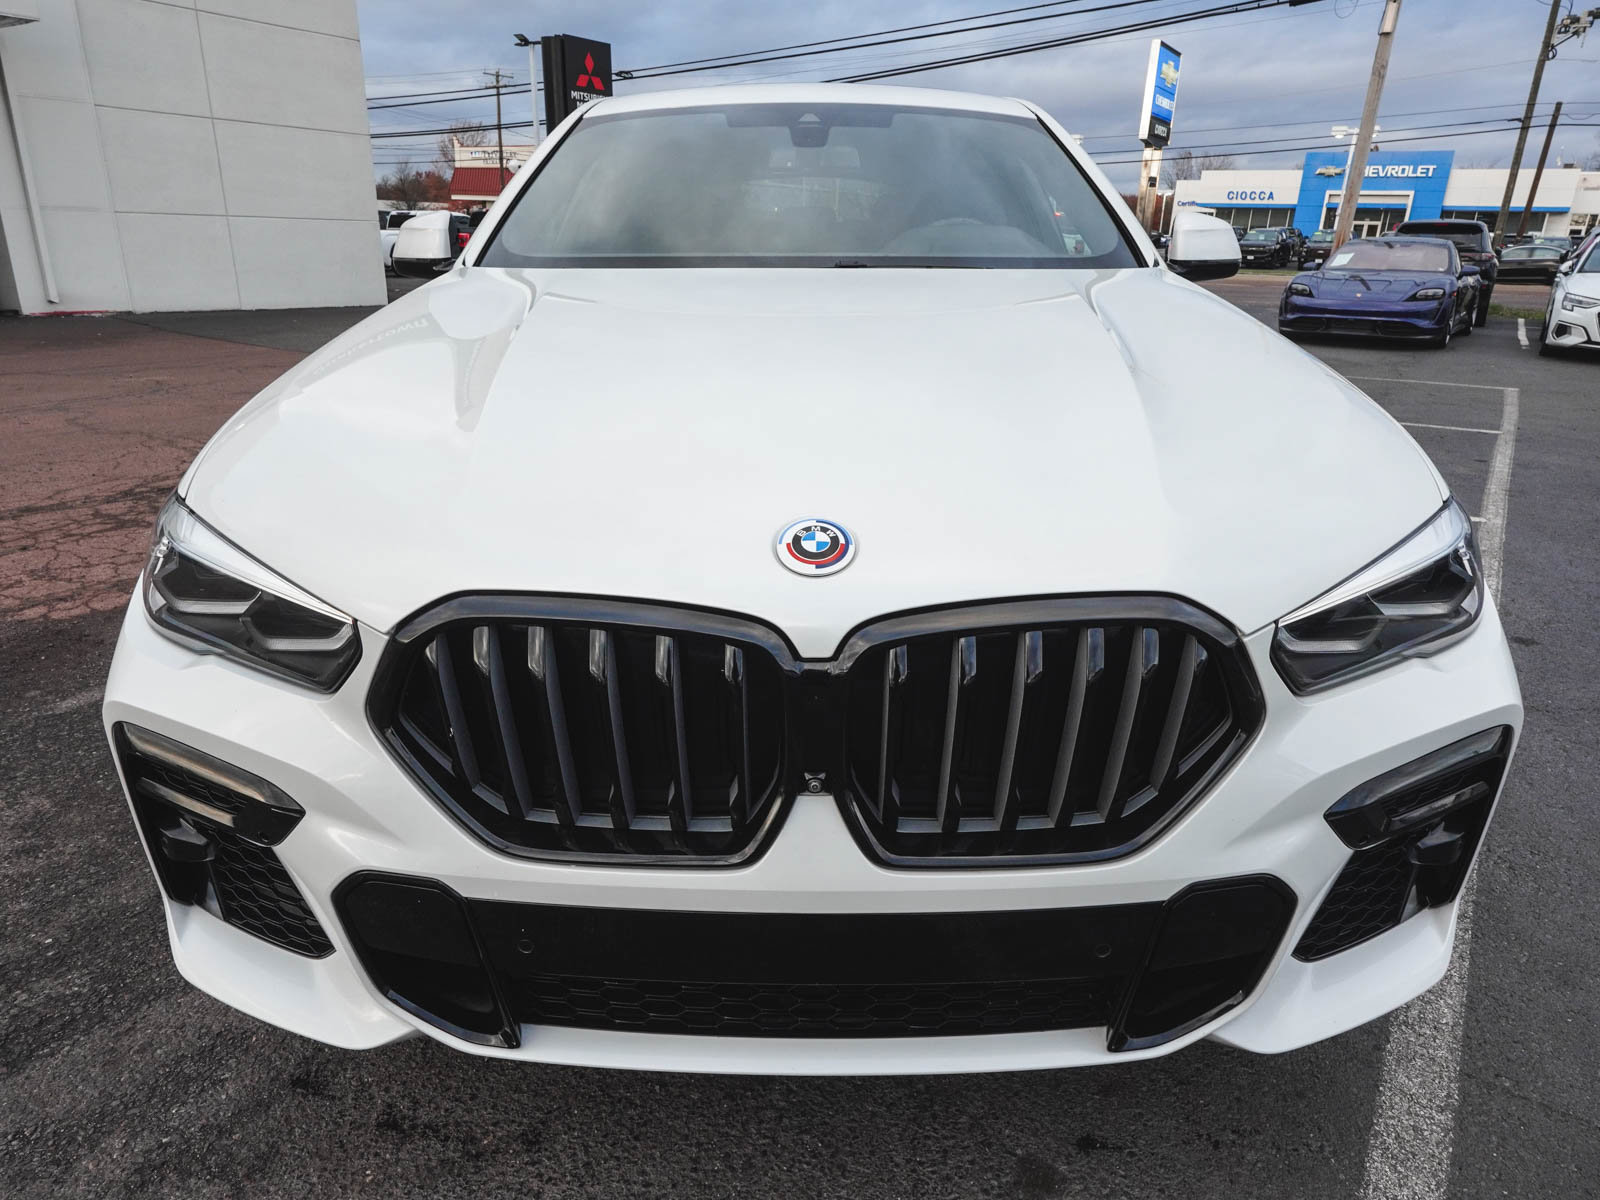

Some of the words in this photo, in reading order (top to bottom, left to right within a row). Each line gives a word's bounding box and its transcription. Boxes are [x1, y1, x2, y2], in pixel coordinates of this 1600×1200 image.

[571, 90, 606, 101] MITSU
[1365, 165, 1437, 178] EVROLET
[1227, 191, 1275, 201] CIOCCA
[796, 525, 837, 537] BMW
